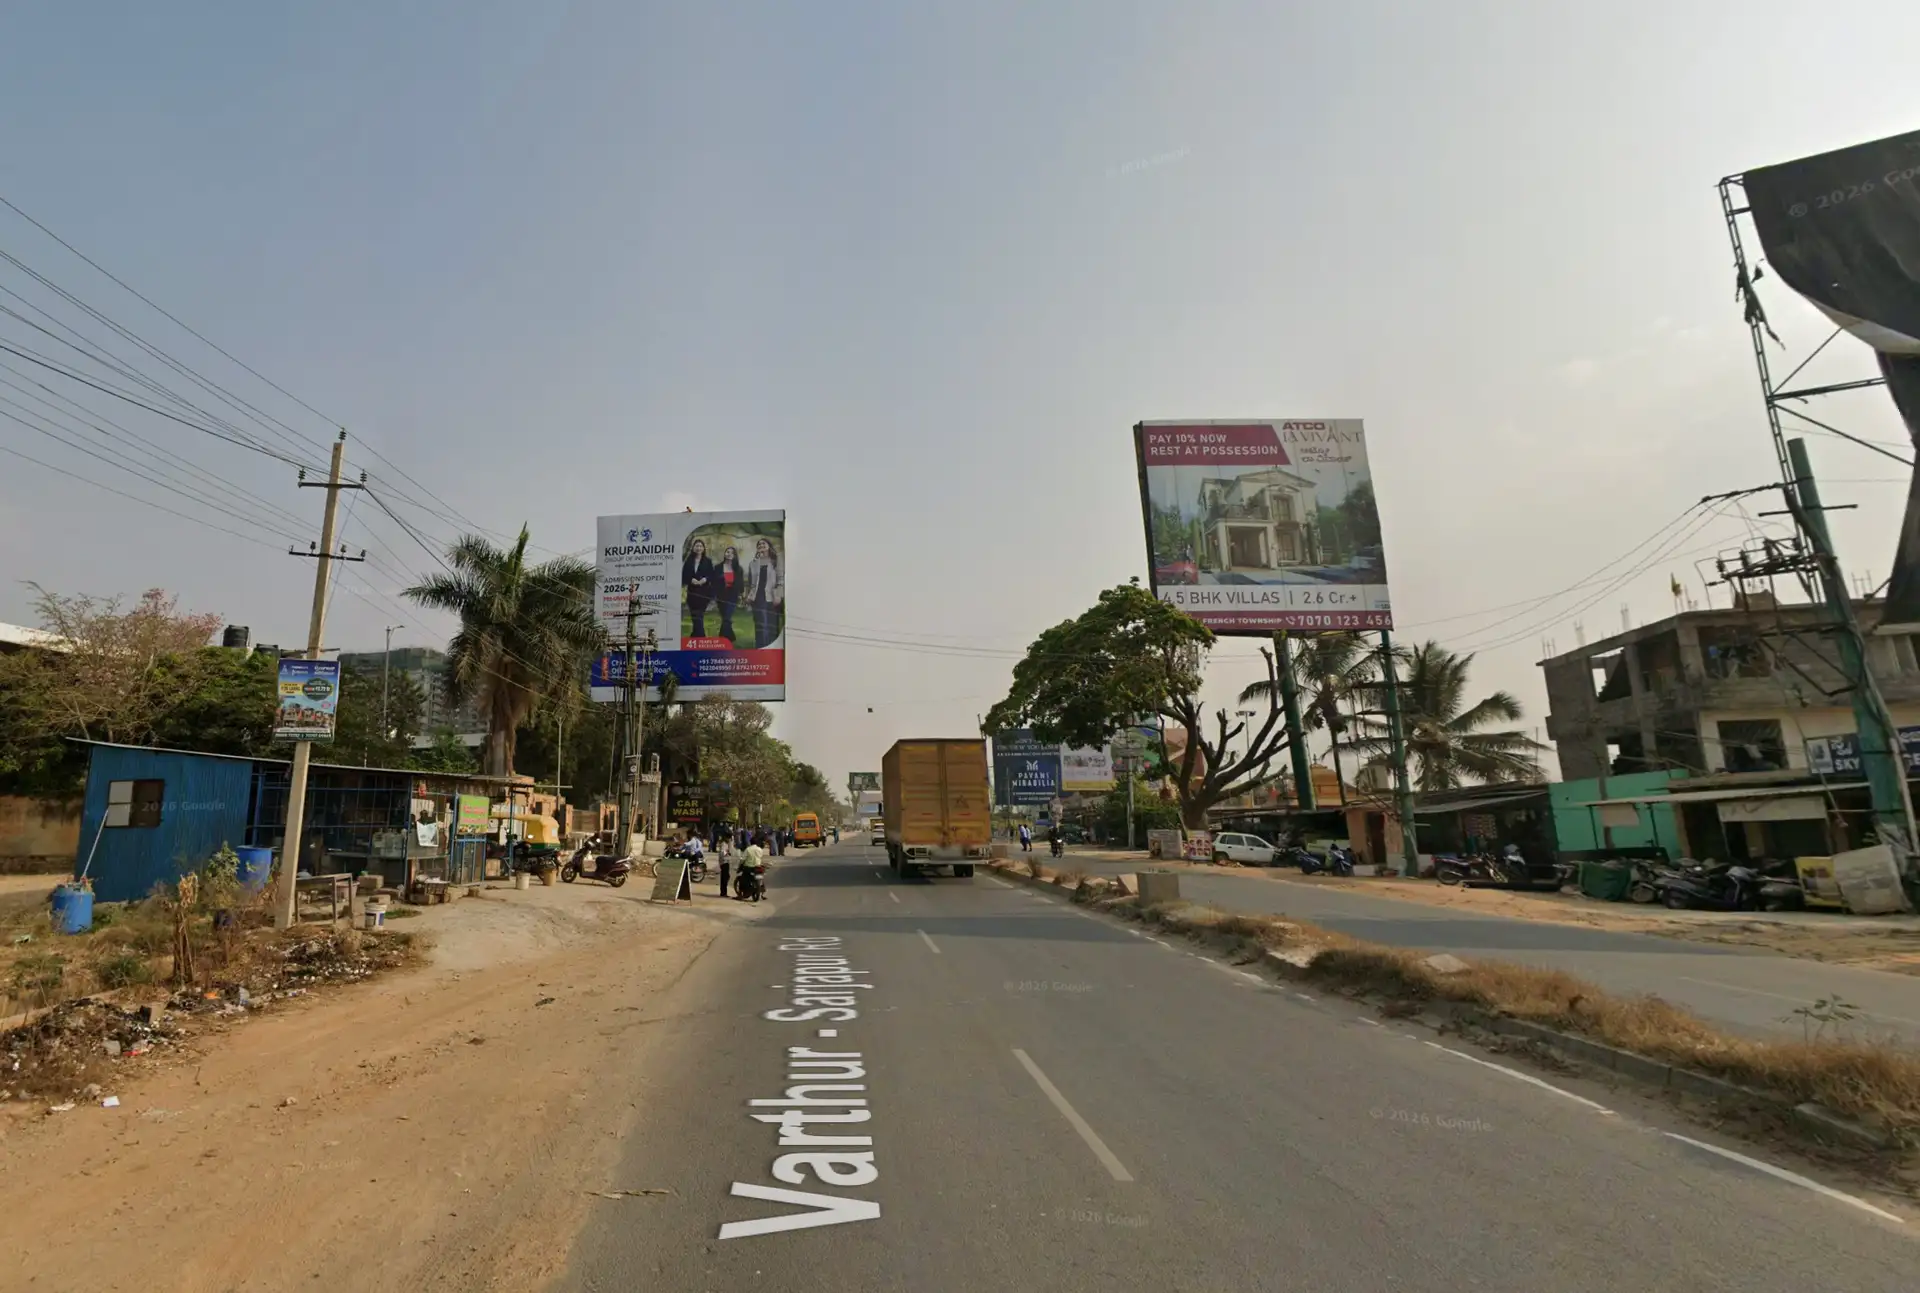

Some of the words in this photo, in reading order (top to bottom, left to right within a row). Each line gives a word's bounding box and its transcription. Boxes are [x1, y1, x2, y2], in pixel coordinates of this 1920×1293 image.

[1282, 422, 1325, 430] ATCO
[1150, 434, 1172, 444] PAY
[1175, 434, 1196, 443] 10%
[1200, 434, 1227, 443] NOW
[1300, 425, 1362, 443] VIVANT
[1151, 446, 1180, 456] REST
[1185, 446, 1200, 456] AT
[1203, 446, 1278, 456] POSSESSION
[604, 544, 675, 556] KRUPANIDHI
[604, 576, 645, 584] ADMISSIONS
[604, 584, 640, 593] 2026-27
[1163, 592, 1185, 604] 4.5
[1190, 592, 1222, 604] BHK
[1225, 592, 1280, 604] VILLAS
[1303, 592, 1324, 604] 2.6
[1328, 592, 1357, 604] Cr.+
[1298, 616, 1331, 626] 7070
[1336, 616, 1360, 626] 123
[1366, 615, 1391, 626] 456
[686, 640, 697, 648] 41
[1834, 758, 1860, 771] SKY
[672, 808, 704, 816] WASH
